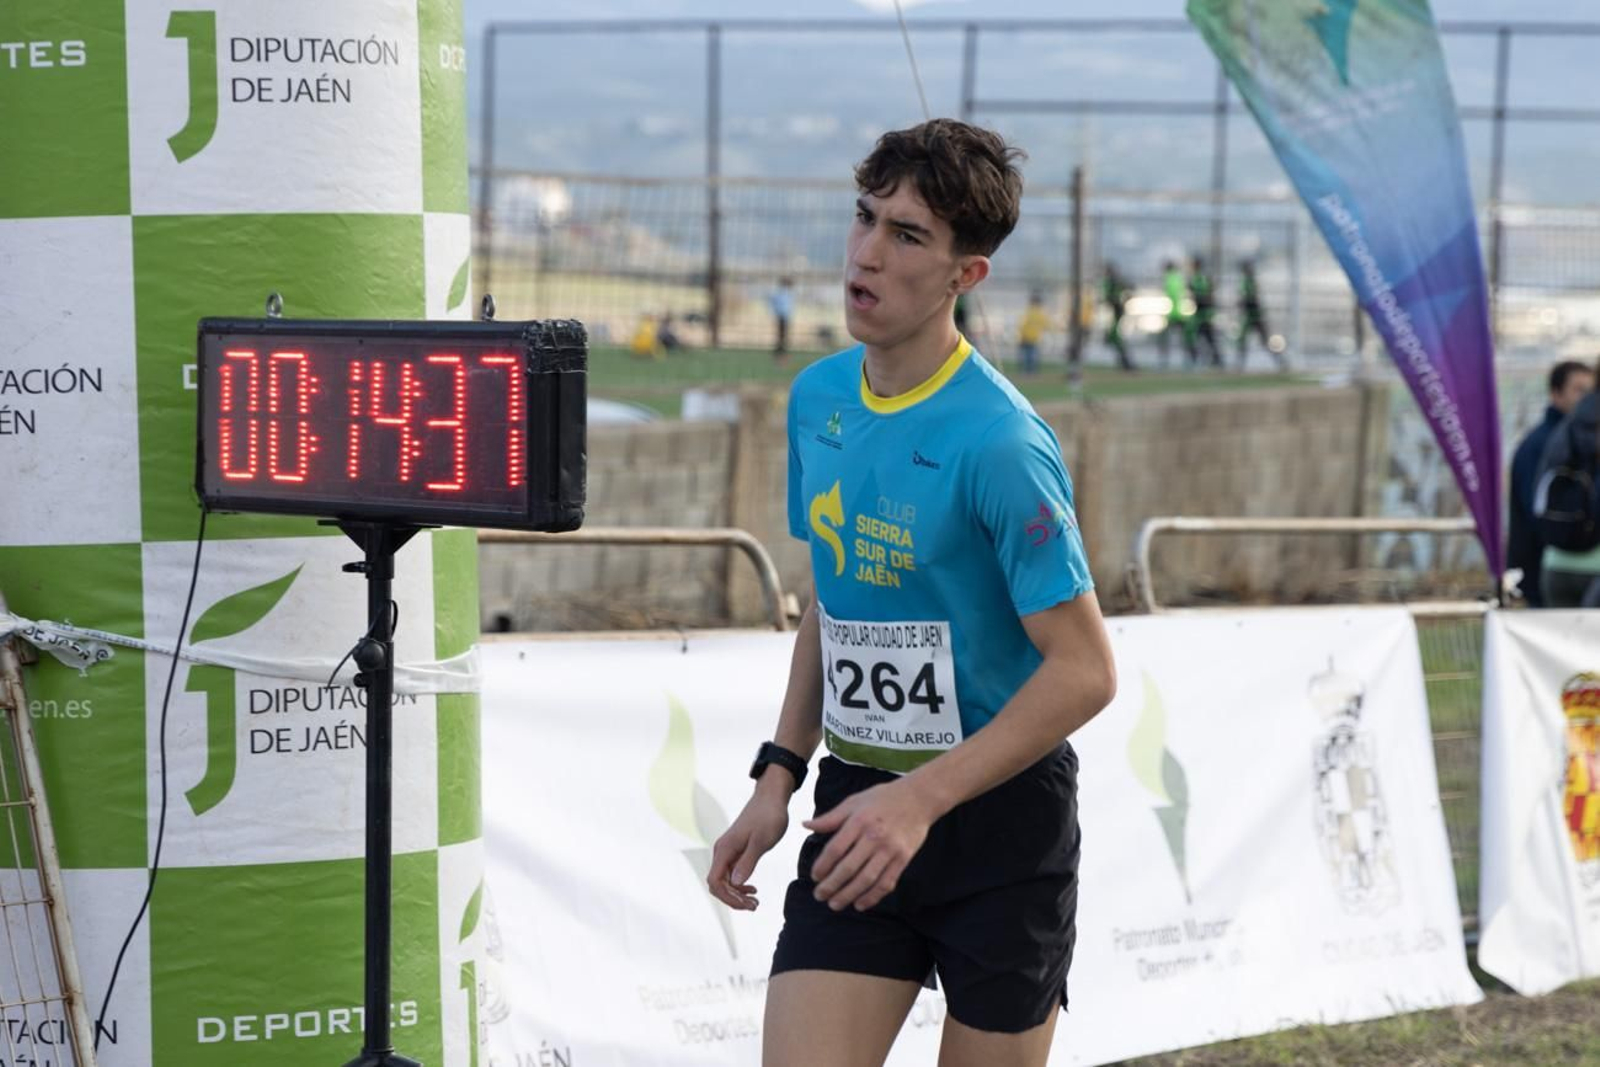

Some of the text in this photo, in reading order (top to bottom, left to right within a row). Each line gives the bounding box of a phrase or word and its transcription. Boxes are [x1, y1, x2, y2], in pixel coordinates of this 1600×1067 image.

[230, 34, 399, 66] DIPUTACIÓN
[231, 72, 352, 103] DE JAÉN
[0, 362, 103, 395] ACIÓN
[856, 513, 914, 549] SIERRA
[855, 538, 916, 571] SUR DE
[833, 622, 874, 647] POPULAR
[873, 625, 903, 649] CIUDAD
[905, 625, 918, 648] DE
[919, 624, 943, 648] JAEN
[249, 684, 417, 715] DIPUTAC
[826, 711, 956, 745] MARTINEZ VILLAREJO
[864, 713, 886, 723] IVAN
[250, 719, 368, 754] DE JAÉN
[0, 1018, 117, 1045] TACIN
[197, 1000, 419, 1044] DEPORTS
